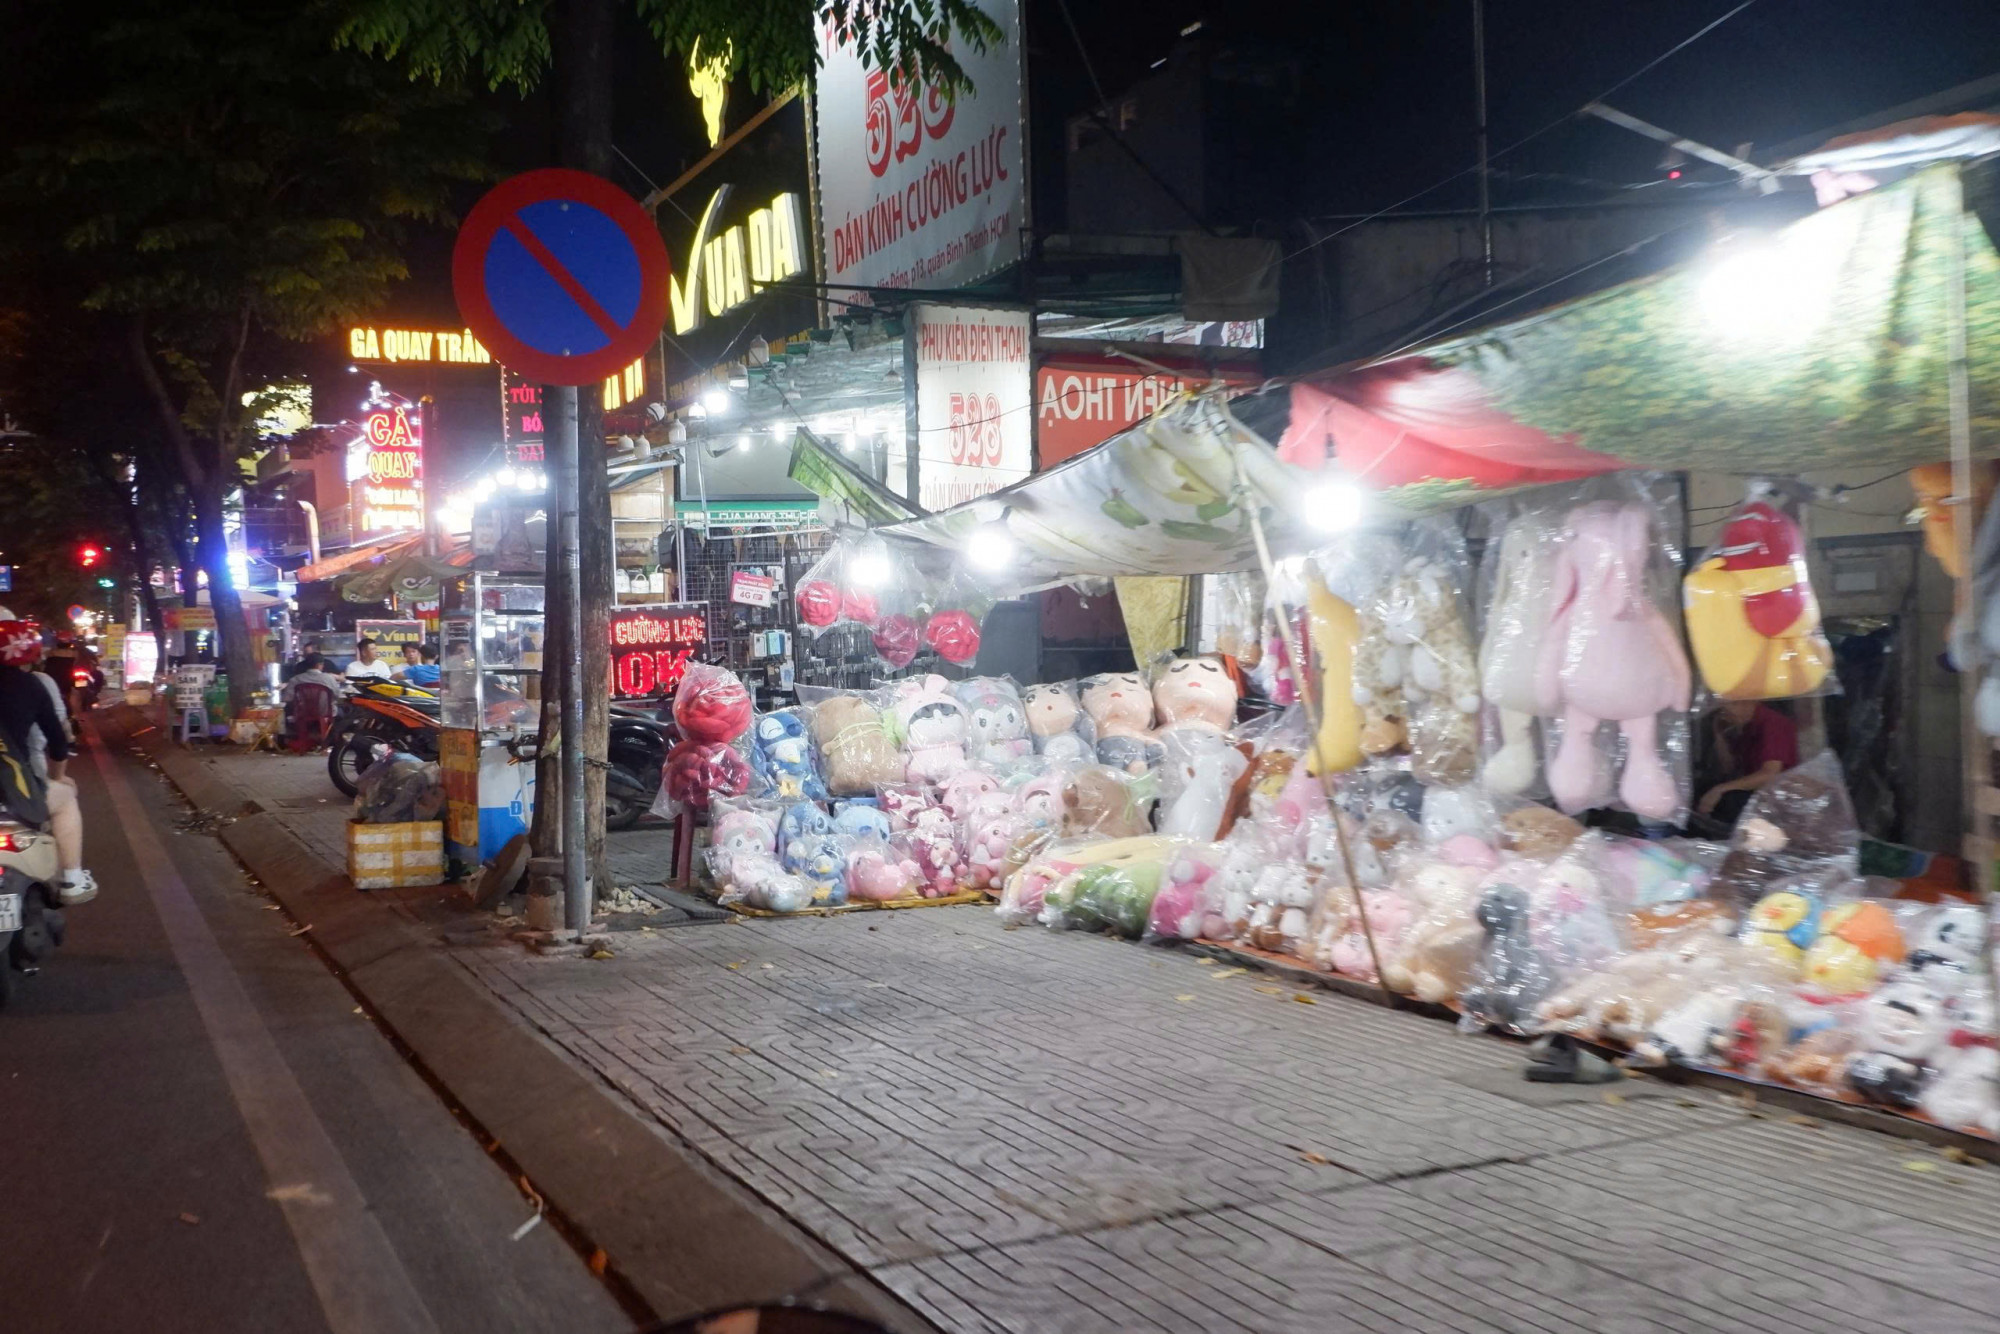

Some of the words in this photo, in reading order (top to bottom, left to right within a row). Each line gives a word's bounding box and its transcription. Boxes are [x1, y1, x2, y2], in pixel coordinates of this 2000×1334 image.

[834, 210, 865, 274] DÁN
[867, 191, 904, 255] KÍNH
[907, 150, 968, 232] CƯỜNG
[971, 124, 1008, 205] LỰC
[351, 326, 380, 359] GÀ
[383, 329, 433, 362] QUAY
[922, 323, 943, 373] PHỤ
[945, 316, 968, 373] KIỆN
[970, 316, 994, 373] ĐIỆN
[995, 325, 1026, 374] THOẠI
[368, 406, 415, 446] GÀ
[522, 411, 544, 433] BÓ
[949, 392, 1003, 468] 528
[369, 451, 416, 484] QUAY
[739, 590, 751, 600] 4G
[616, 615, 671, 645] CƯỜNG
